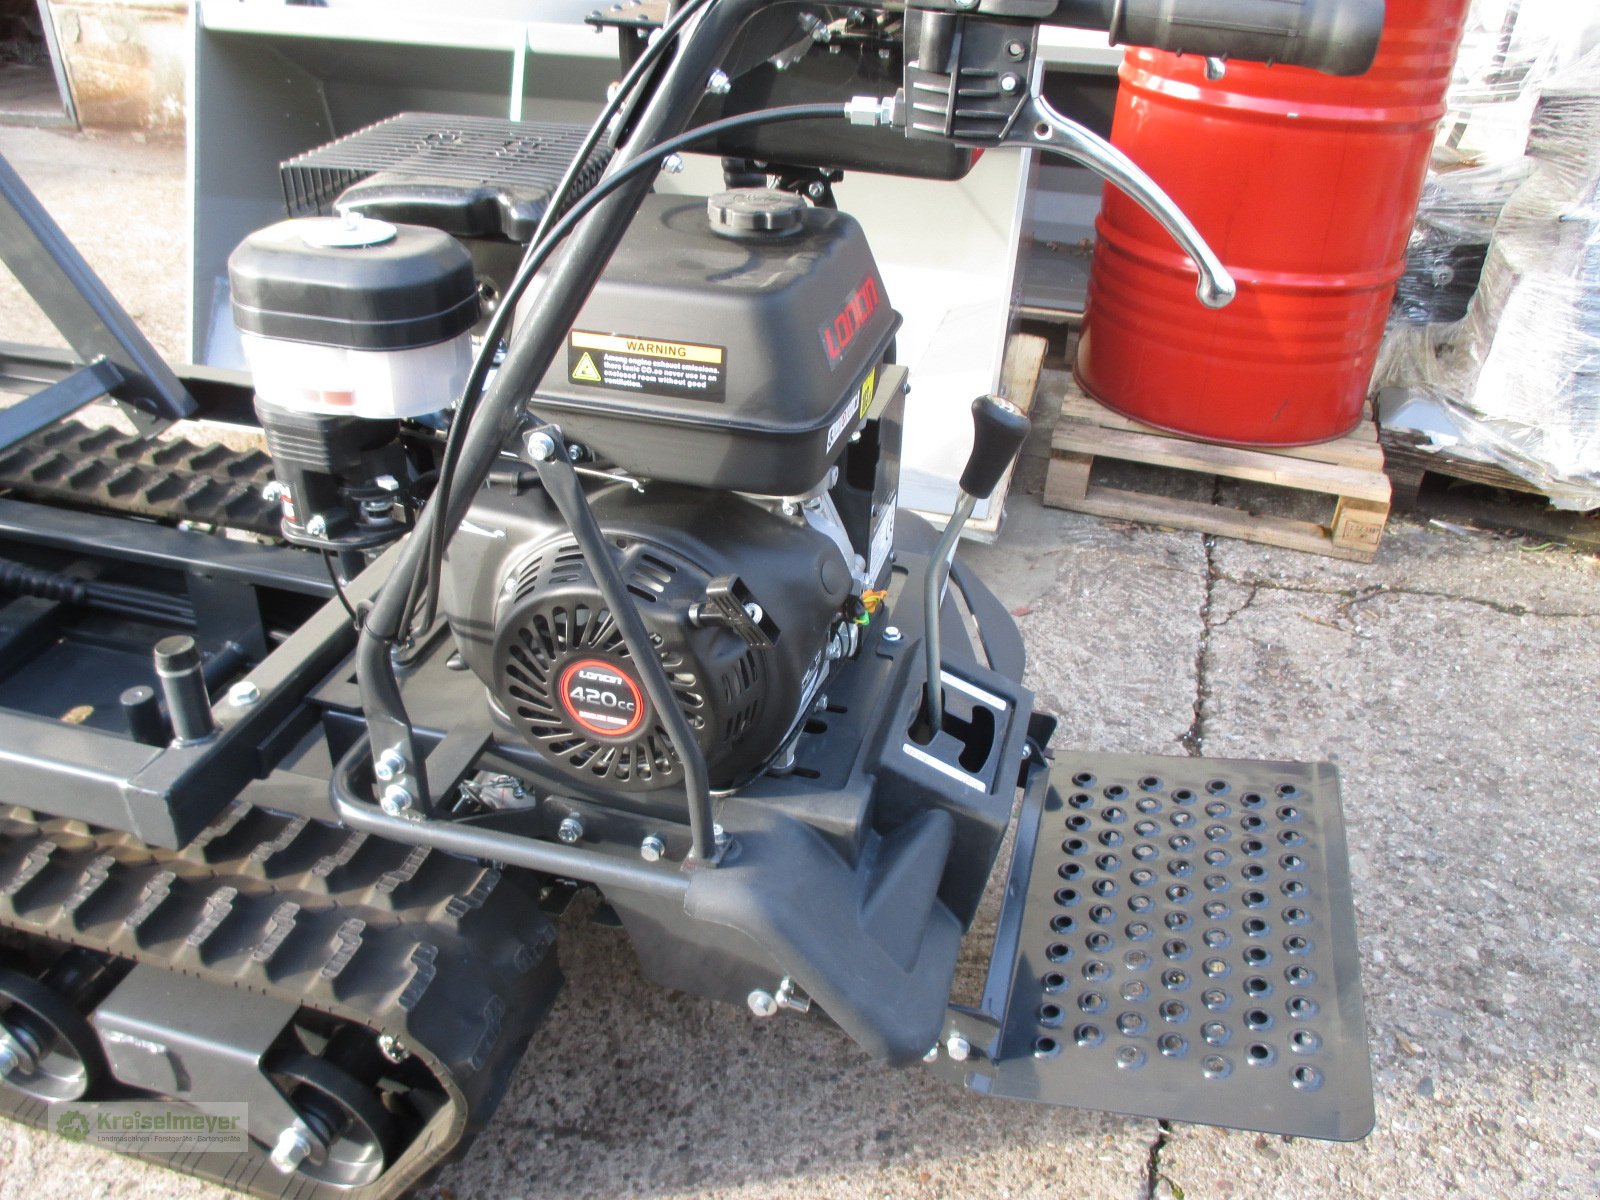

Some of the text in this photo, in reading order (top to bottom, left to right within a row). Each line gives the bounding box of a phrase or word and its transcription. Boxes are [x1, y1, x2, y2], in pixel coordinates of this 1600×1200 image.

[627, 341, 687, 357] WARNING
[604, 353, 627, 364] Among
[628, 358, 652, 367] engine
[653, 360, 681, 369] exhaust
[604, 362, 622, 370] there
[685, 372, 698, 380] use
[604, 370, 707, 389] enclosed room without good
